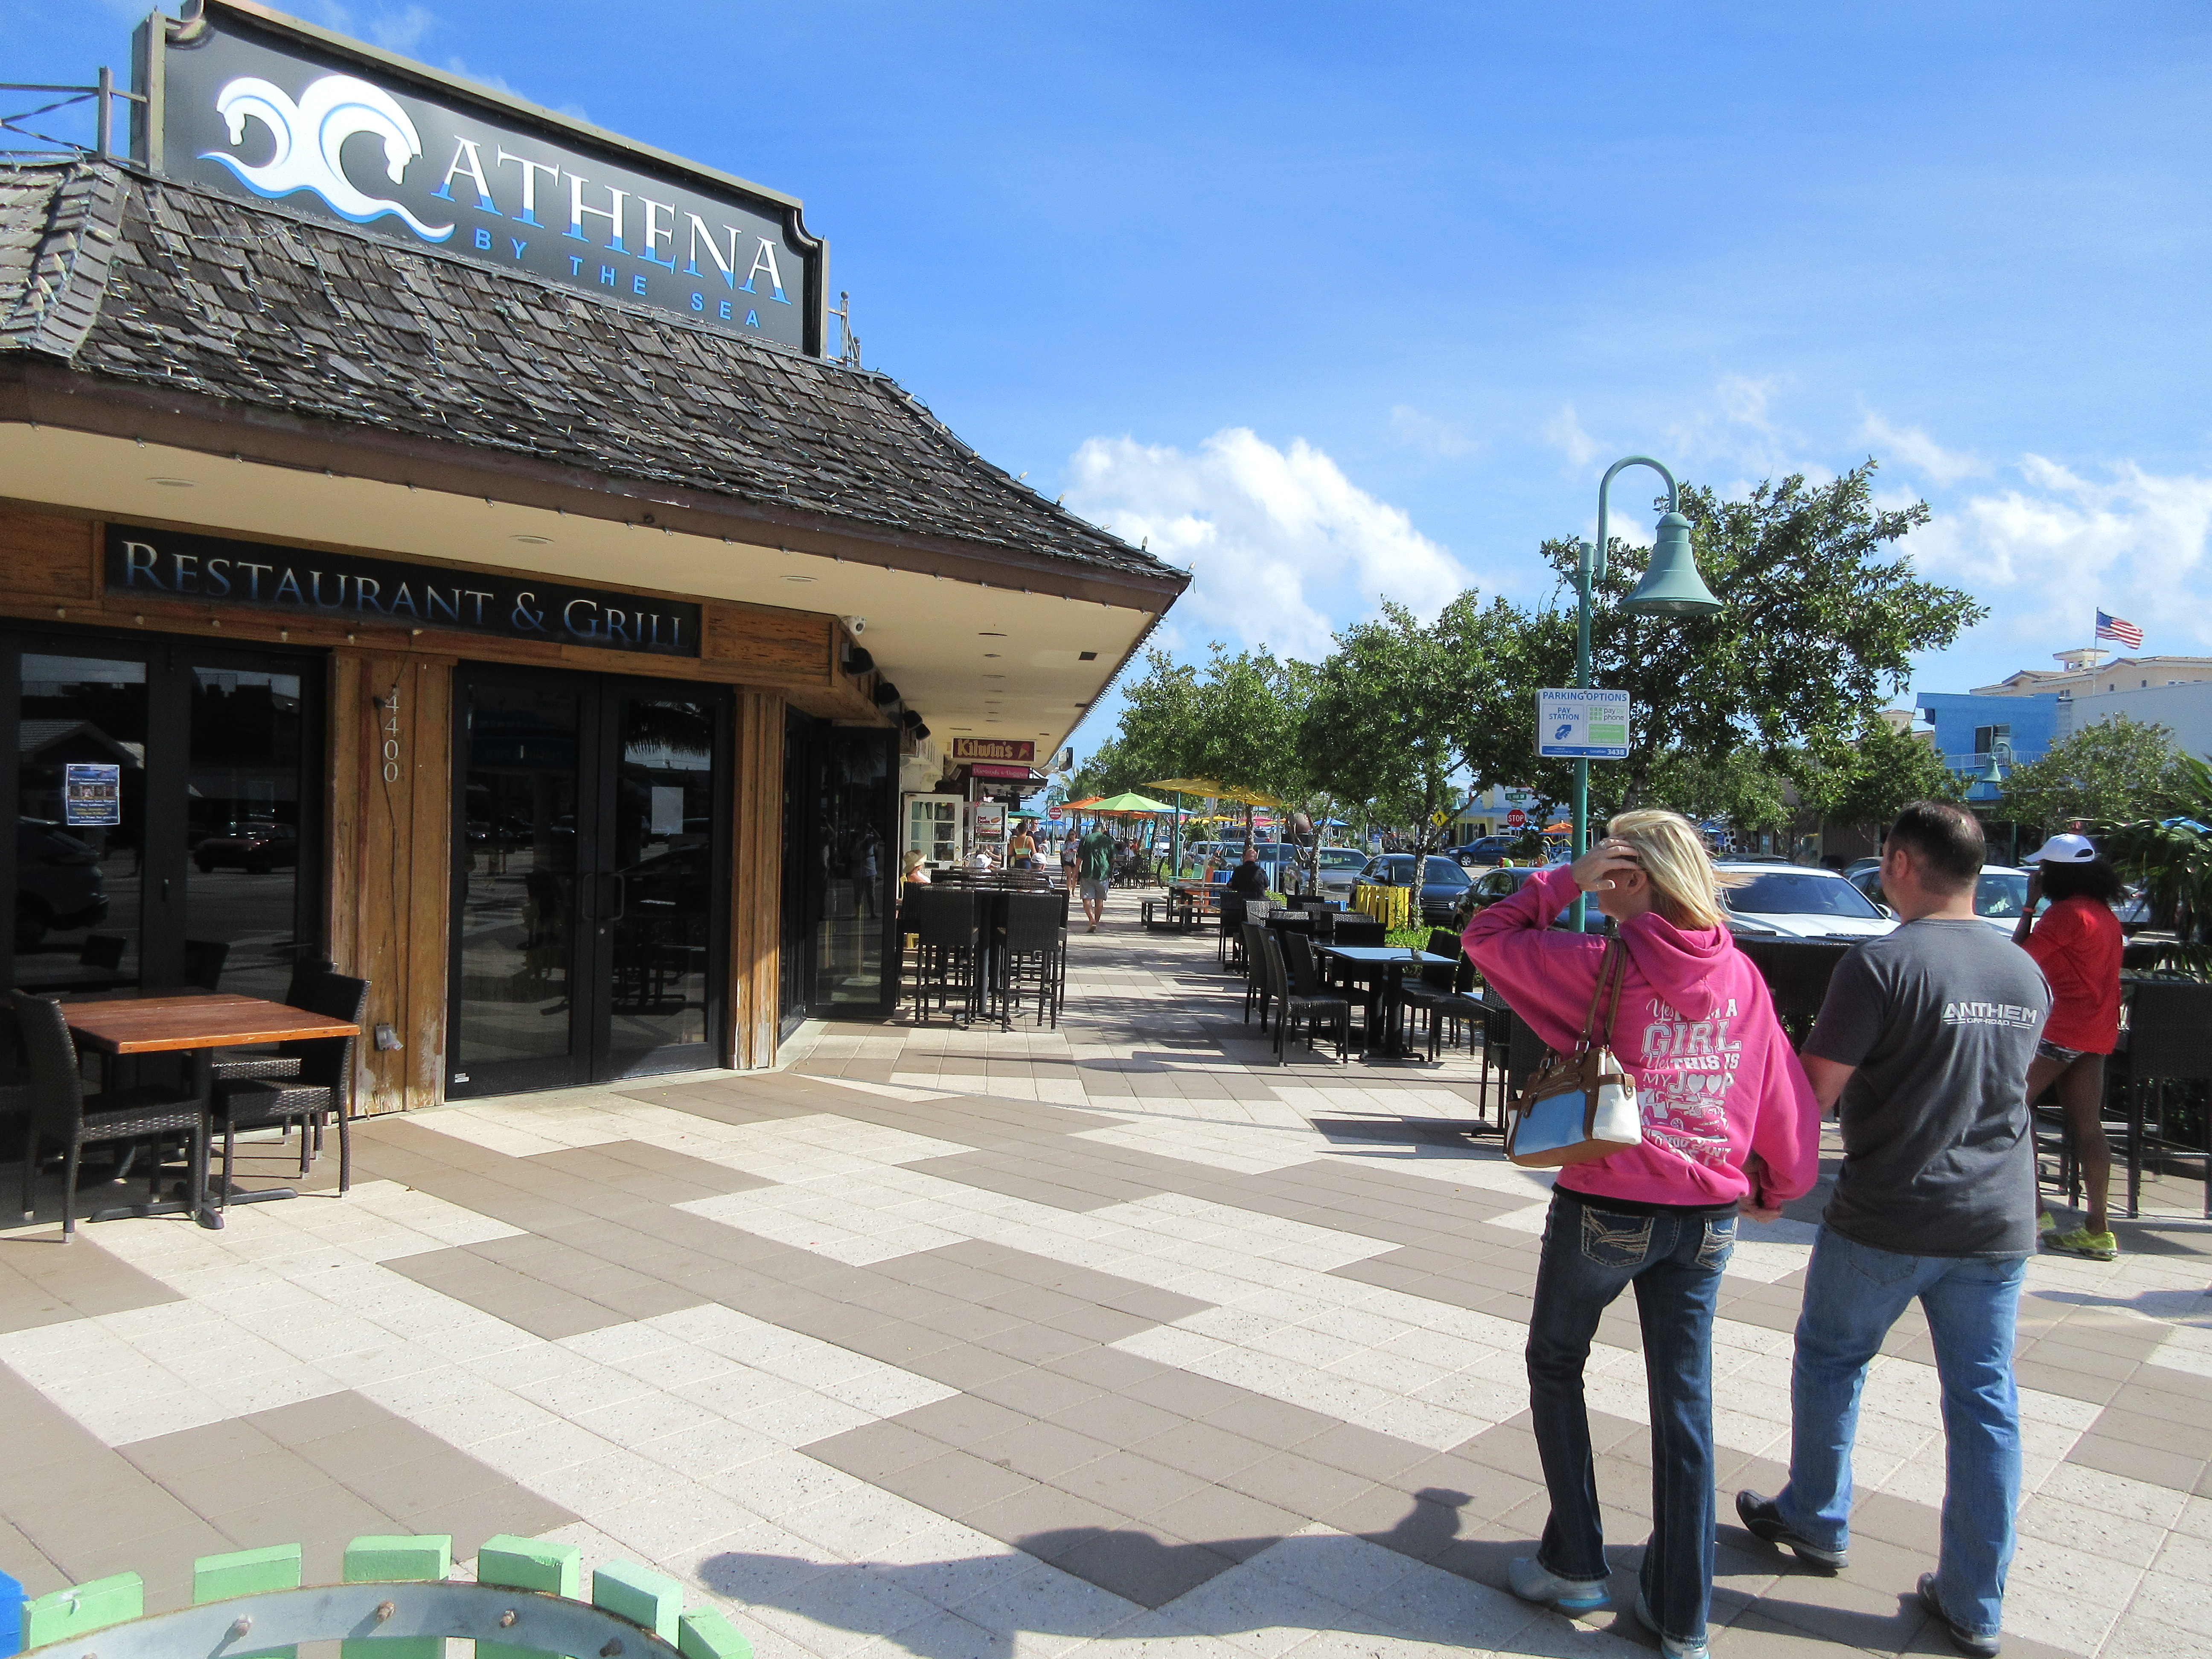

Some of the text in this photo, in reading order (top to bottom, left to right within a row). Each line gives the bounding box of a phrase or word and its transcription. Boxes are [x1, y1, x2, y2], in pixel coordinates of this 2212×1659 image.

[430, 134, 792, 306] ATHENA
[474, 227, 760, 329] BY THE SEA
[122, 540, 689, 649] RESTAURANT & GRILL
[1543, 691, 1627, 701] PARKING OPTIONS
[384, 693, 400, 783] 4400
[957, 738, 1013, 758] Kilwin's
[1645, 998, 1674, 1025] Yes
[1725, 998, 1738, 1017] A
[1942, 1002, 2037, 1024] ANTHEM
[1966, 1018, 2010, 1026] OFF-ROAD
[1641, 1019, 1742, 1058] GIRL
[1670, 1054, 1720, 1070] THIS
[1723, 1053, 1740, 1070] IS
[1642, 1072, 1672, 1087] MY
